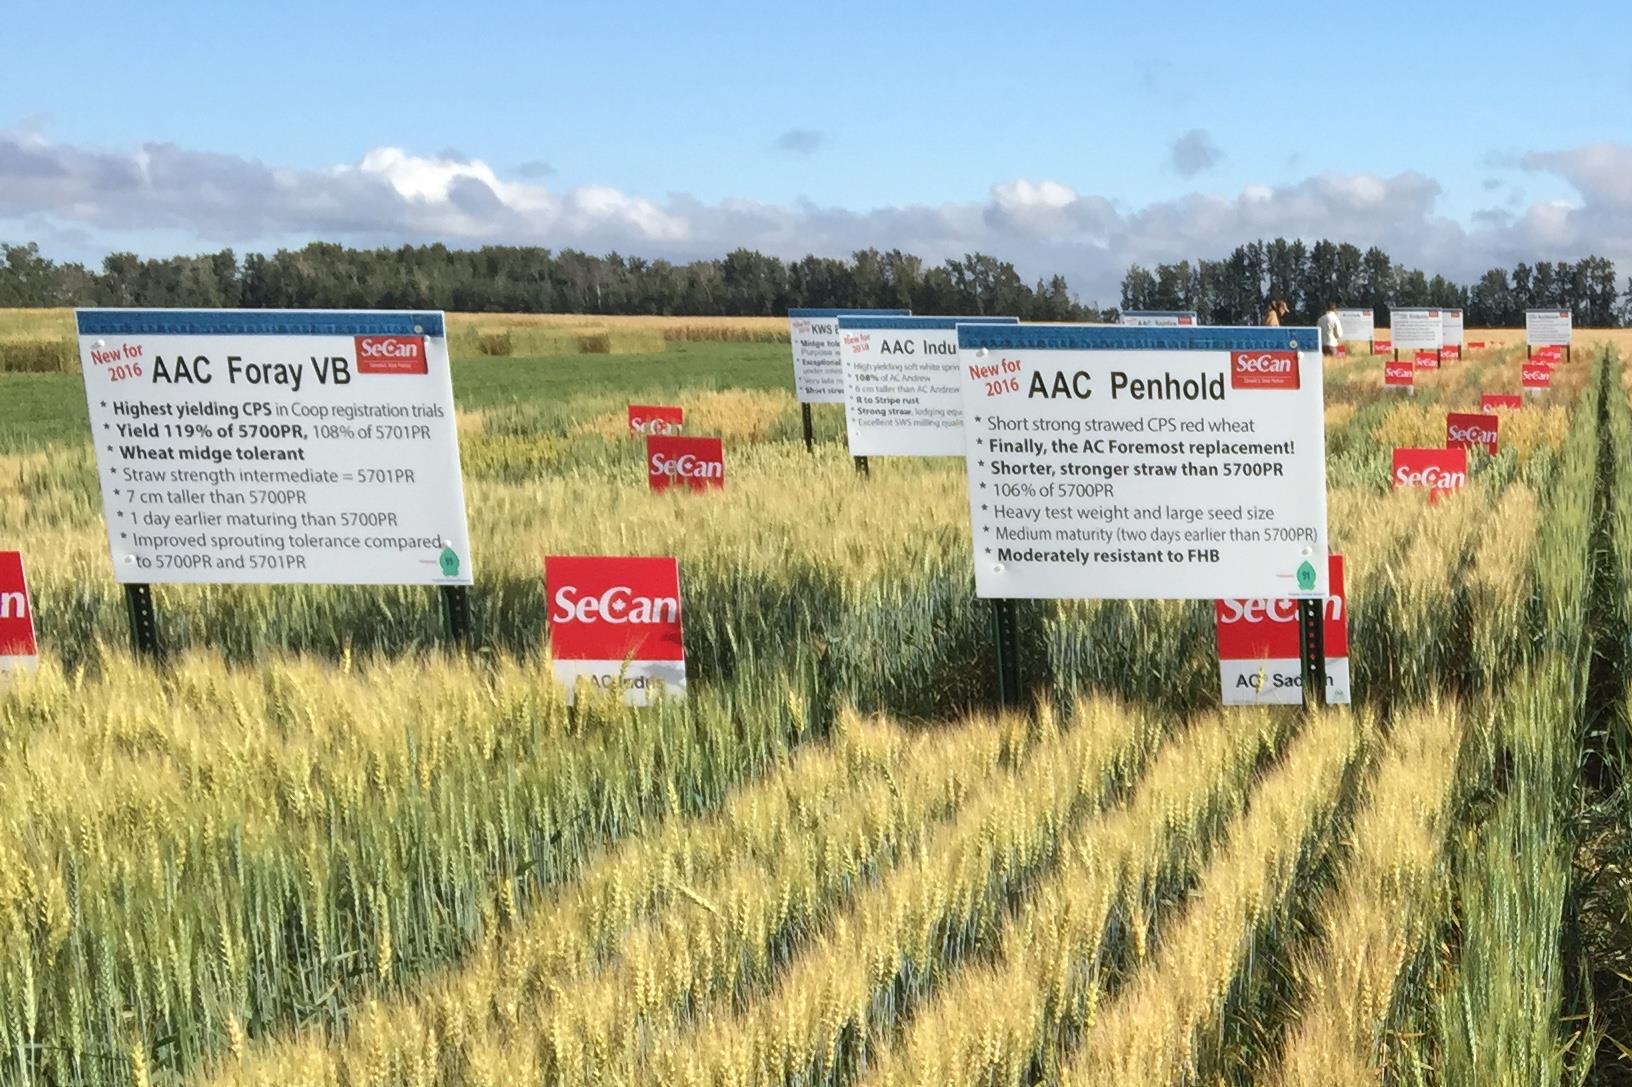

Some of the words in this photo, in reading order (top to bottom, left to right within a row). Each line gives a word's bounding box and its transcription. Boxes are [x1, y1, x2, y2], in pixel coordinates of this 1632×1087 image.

[812, 324, 832, 334] KWS
[90, 349, 121, 366] New
[123, 343, 144, 358] for
[361, 339, 417, 358] SeCan
[880, 340, 914, 354] AAC
[108, 362, 143, 382] 2016
[968, 364, 999, 380] New
[1002, 358, 1022, 374] for
[1236, 354, 1291, 372] SeCan
[152, 355, 212, 384] AAC
[227, 355, 303, 392] Foray
[310, 356, 352, 385] VB
[1386, 368, 1412, 378] SeCan
[1524, 370, 1550, 380] SeCan
[985, 377, 1020, 397] 2016
[1028, 370, 1092, 400] AAC
[1110, 371, 1226, 400] Penhold
[113, 401, 173, 419] Highest
[176, 401, 239, 420] yielding
[242, 402, 272, 416] CPS
[276, 402, 288, 416] in
[291, 402, 328, 420] Coop
[332, 402, 408, 420] registration
[412, 403, 444, 418] trials
[857, 407, 886, 416] Strong
[116, 423, 159, 438] Yield
[164, 424, 213, 438] 119%
[217, 424, 234, 438] of
[239, 424, 308, 440] 5700PR,
[313, 425, 354, 439] 108%
[358, 424, 373, 440] of
[376, 425, 431, 440] 5701PR
[988, 416, 1030, 431] Short
[1032, 416, 1080, 434] strong
[1084, 417, 1144, 432] strawed
[1148, 418, 1177, 432] CPS
[1180, 418, 1204, 432] red
[1208, 418, 1256, 432] wheat
[1448, 424, 1498, 443] SeCan
[119, 446, 175, 460] Wheat
[178, 446, 232, 464] midge
[237, 446, 305, 460] tolerant
[989, 438, 1048, 456] Finally,
[1051, 439, 1080, 454] the
[1082, 440, 1107, 454] AC
[1108, 440, 1184, 454] Foremost
[1189, 440, 1295, 458] replacement!
[651, 452, 722, 478] SeCan
[991, 460, 1056, 477] Shorter,
[1060, 462, 1129, 479] stronger
[1133, 463, 1178, 476] straw
[1182, 462, 1218, 476] than
[1223, 462, 1284, 476] 5700PR
[122, 467, 166, 482] Straw
[170, 468, 235, 486] strength
[240, 468, 338, 483] intermediate
[343, 472, 353, 480] =
[358, 469, 415, 483] 5701PR
[1396, 466, 1465, 489] SeCan
[126, 490, 135, 504] 7
[140, 492, 163, 504] cm
[168, 490, 206, 504] taller
[210, 490, 245, 504] than
[250, 490, 307, 504] 5700PR
[994, 483, 1036, 498] 106%
[1039, 482, 1054, 498] of
[1058, 484, 1114, 498] 5700PR
[130, 512, 138, 525] 1
[143, 511, 170, 528] day
[174, 512, 222, 526] earlier
[226, 512, 296, 530] maturing
[301, 512, 336, 526] than
[340, 512, 398, 526] 5700PR
[994, 504, 1041, 522] Heavy
[1045, 506, 1073, 520] test
[1077, 504, 1130, 523] weight
[1133, 506, 1162, 520] and
[1166, 506, 1204, 524] large
[1208, 506, 1242, 520] seed
[1246, 506, 1274, 520] size
[132, 532, 207, 550] Improved
[210, 534, 284, 551] sprouting
[288, 534, 360, 548] tolerance
[364, 534, 442, 552] compared
[996, 526, 1052, 541] Medium
[1056, 526, 1113, 544] maturity
[1116, 526, 1146, 542] (two
[1150, 528, 1181, 544] days
[1184, 528, 1226, 542] earlier
[1230, 528, 1260, 542] than
[1264, 528, 1318, 544] 5700PR)
[136, 556, 152, 568] to
[156, 554, 212, 569] 5700PR
[216, 554, 245, 569] and
[250, 555, 306, 569] 5701PR
[998, 548, 1090, 566] Moderately
[1094, 548, 1164, 563] resistant
[1168, 550, 1184, 562] to
[1188, 549, 1220, 562] FHB
[552, 585, 677, 624] SeCan
[1220, 594, 1342, 624] SeCn
